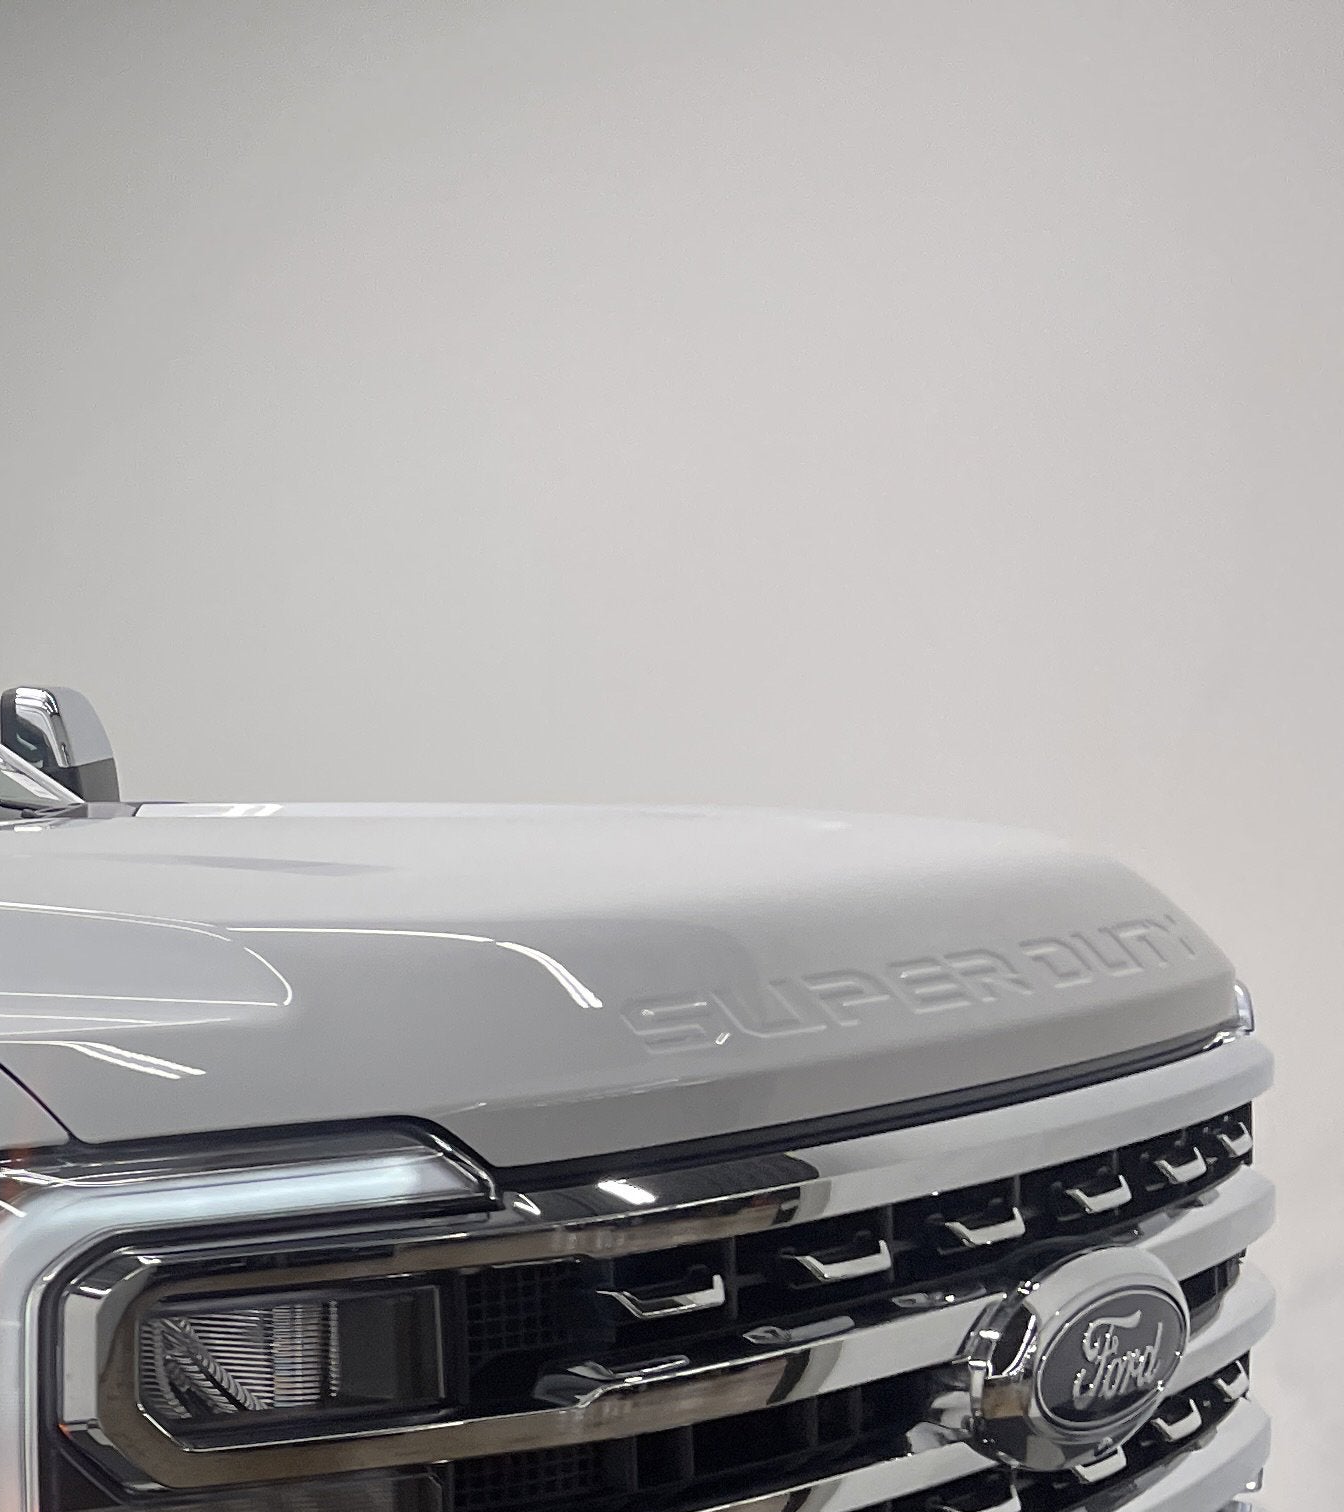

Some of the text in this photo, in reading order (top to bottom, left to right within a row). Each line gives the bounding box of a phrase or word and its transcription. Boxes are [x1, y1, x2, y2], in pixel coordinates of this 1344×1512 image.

[619, 913, 1197, 1055] SUPER DUTY
[1073, 1309, 1163, 1410] Ford
